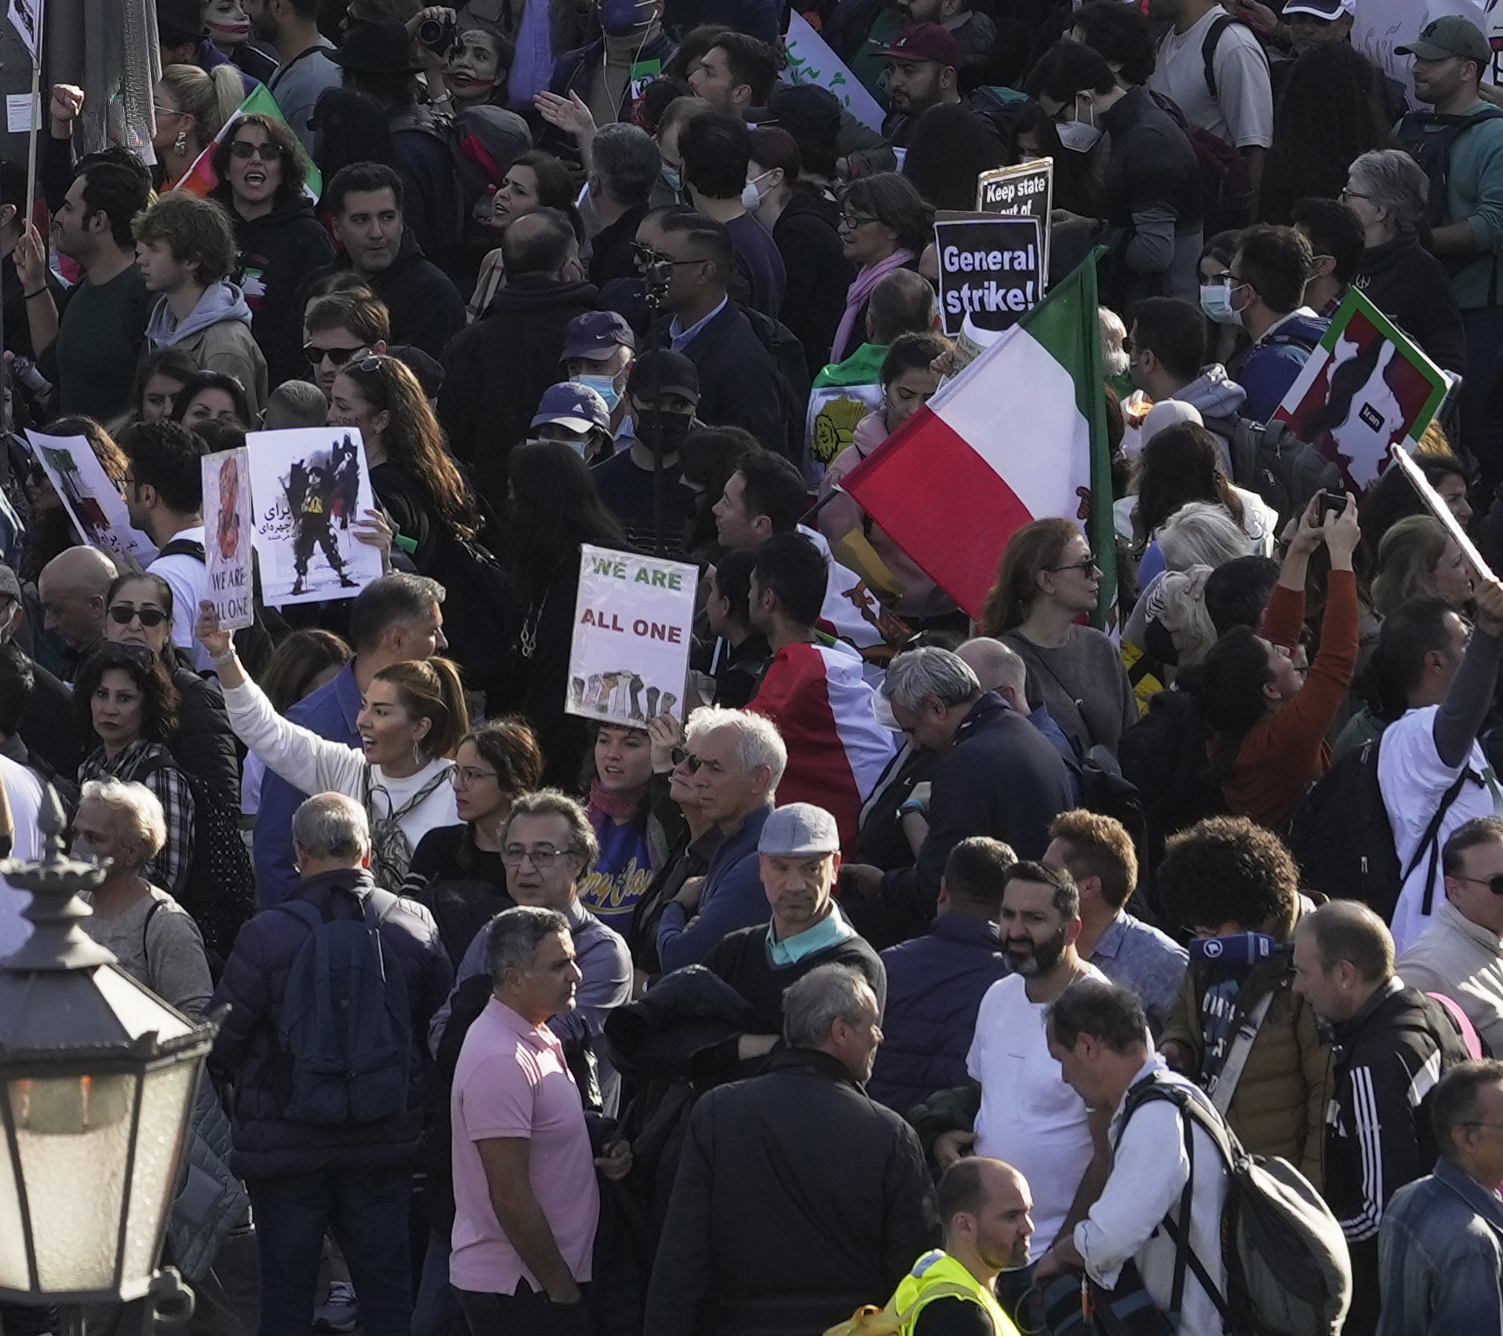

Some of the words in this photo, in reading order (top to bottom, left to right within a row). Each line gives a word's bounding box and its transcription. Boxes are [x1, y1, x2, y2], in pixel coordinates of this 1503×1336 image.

[986, 183, 1013, 204] Keep
[1016, 177, 1046, 198] state
[943, 246, 1035, 273] General
[945, 280, 1035, 314] strike!
[592, 556, 628, 580] WE
[635, 566, 682, 591] ARE
[580, 608, 625, 633] ALL
[632, 619, 682, 644] ONE
